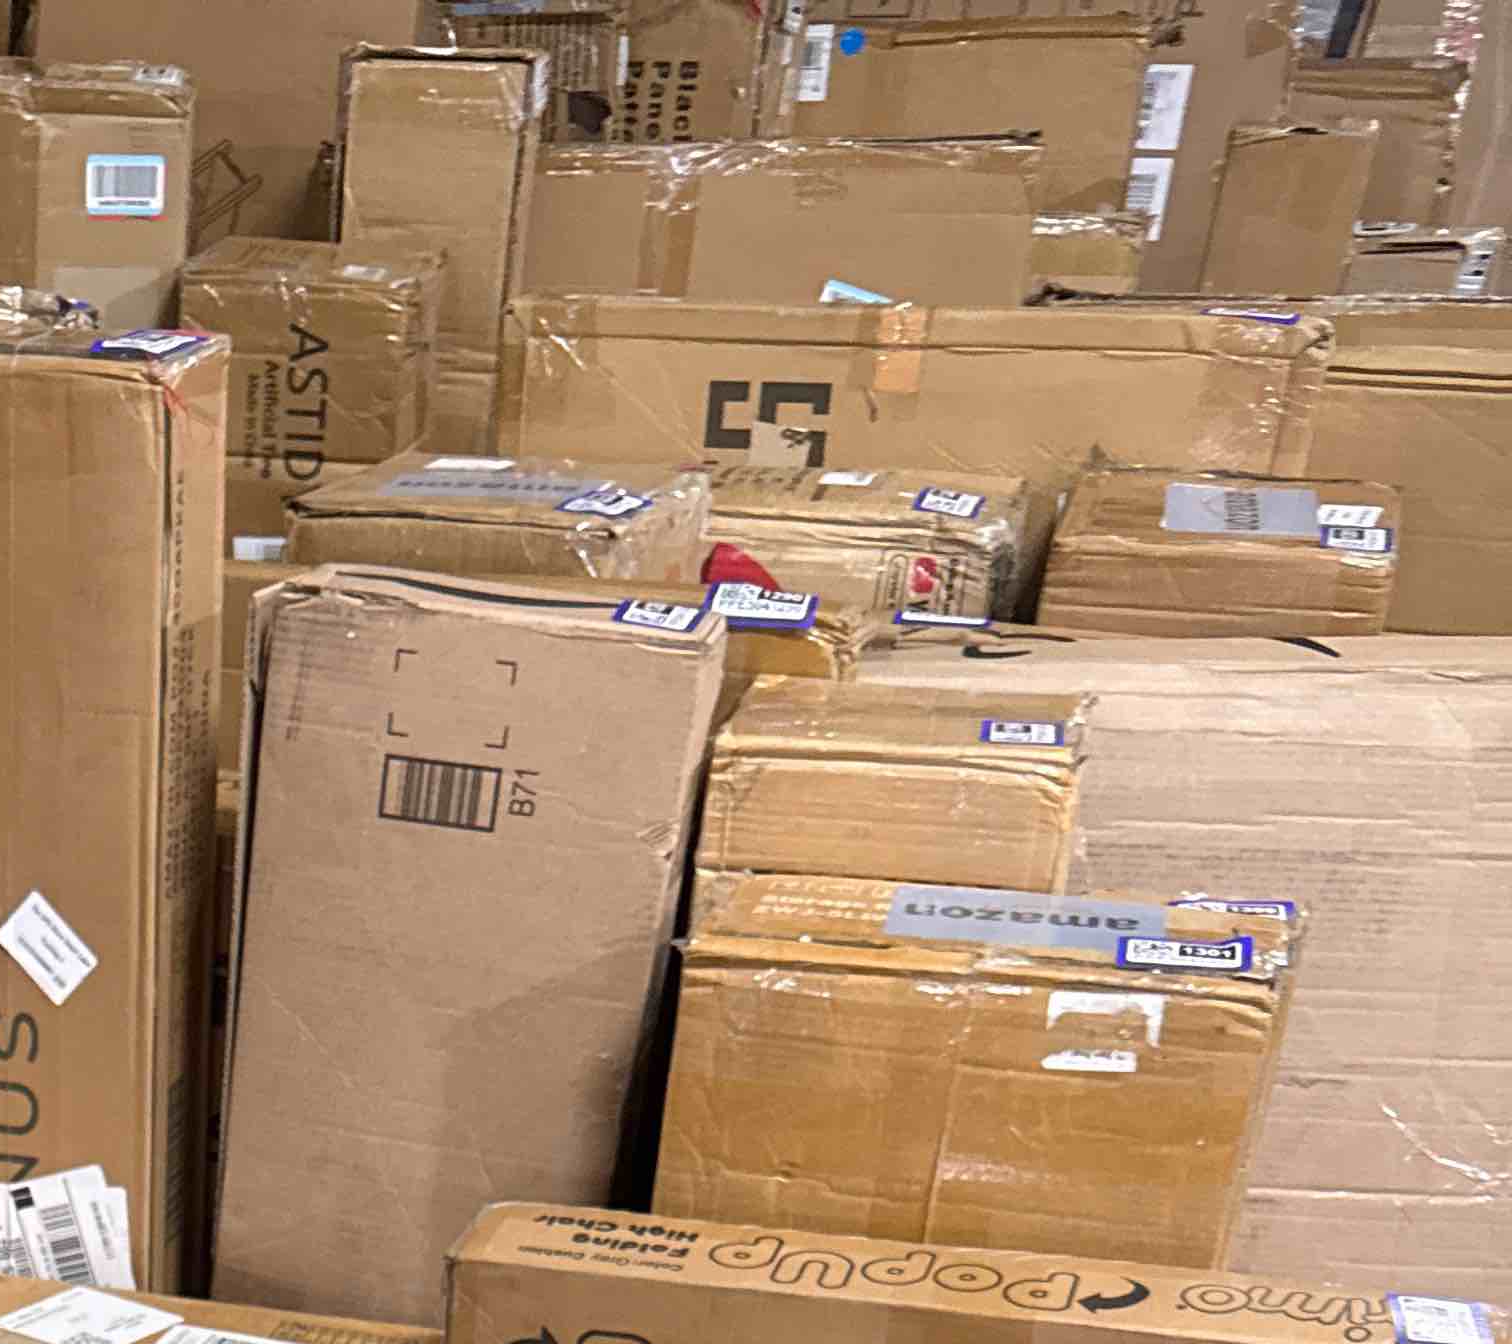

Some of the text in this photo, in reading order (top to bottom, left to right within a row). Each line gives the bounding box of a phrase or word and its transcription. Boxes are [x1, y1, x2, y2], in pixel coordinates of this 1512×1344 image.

[903, 899, 1141, 933] amazon
[532, 1216, 698, 1241] High Chair
[572, 1233, 690, 1256] Folding
[708, 1234, 1083, 1315] PopUp
[1177, 1280, 1396, 1343] rimo
